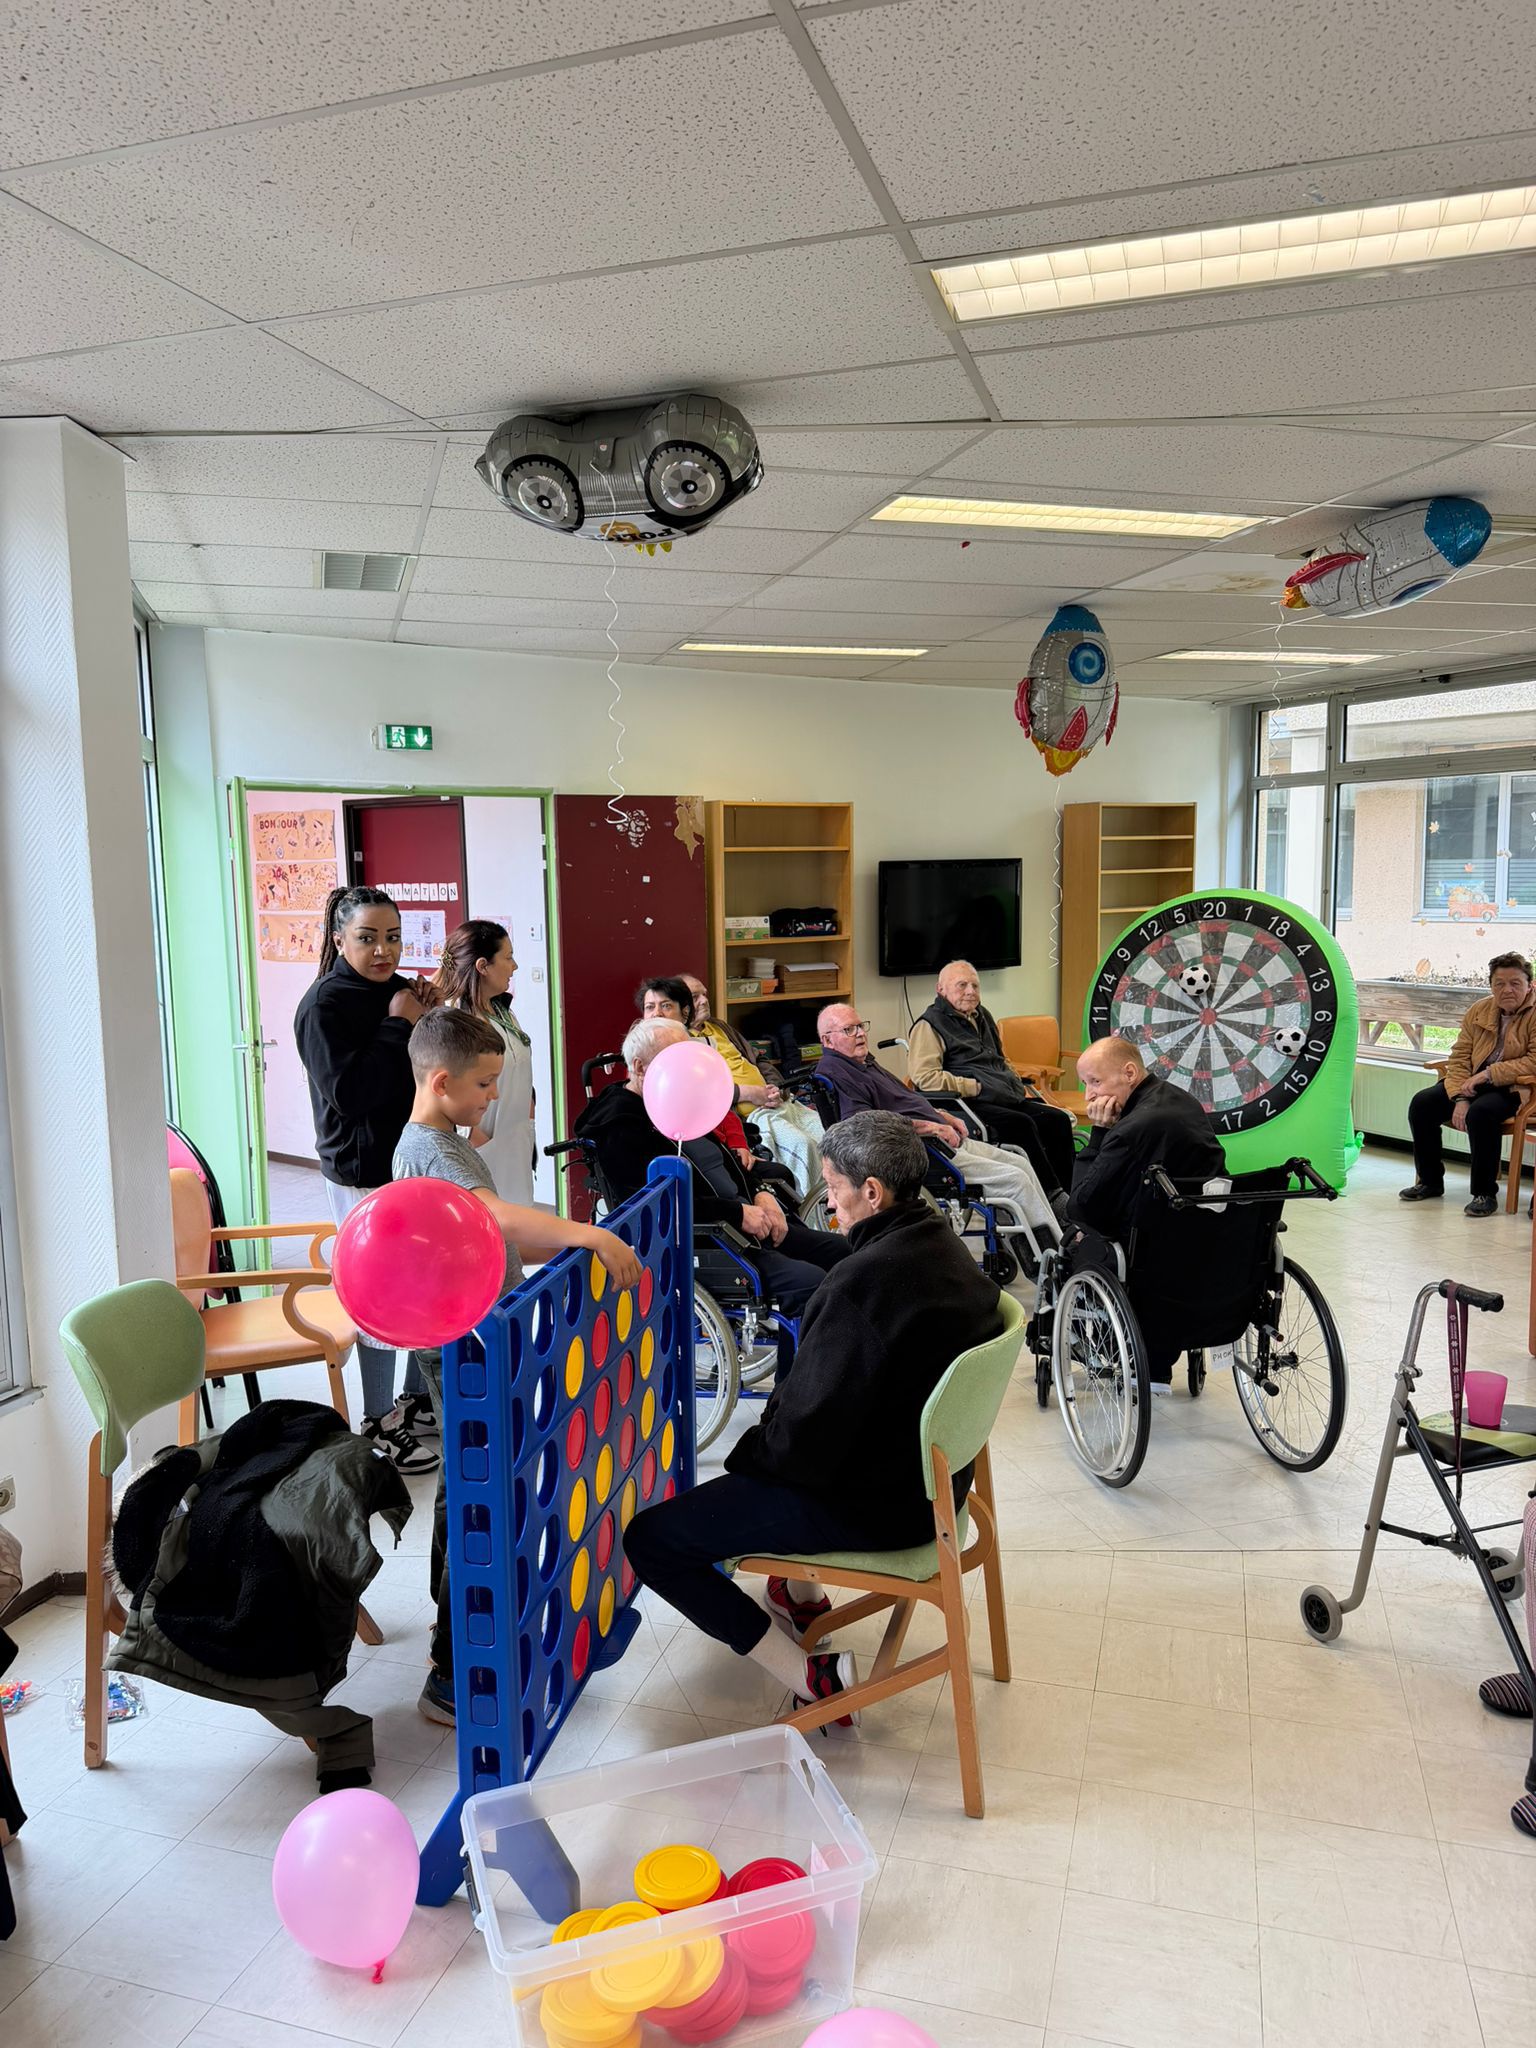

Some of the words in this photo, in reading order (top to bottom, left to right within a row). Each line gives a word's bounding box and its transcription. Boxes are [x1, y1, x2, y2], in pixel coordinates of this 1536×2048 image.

[379, 887, 457, 897] NIMATION
[1174, 908, 1186, 924] 5
[1203, 901, 1227, 919] 20
[1244, 905, 1254, 922] 1
[1139, 920, 1163, 942] 12
[1267, 915, 1291, 938] 18
[1116, 947, 1131, 962] 9
[1296, 943, 1313, 957] 4
[1098, 972, 1117, 993] 14
[1309, 967, 1330, 992] 13
[1092, 1006, 1108, 1024] 11
[1304, 1040, 1326, 1062] 10
[1283, 1070, 1308, 1095] 15
[1259, 1099, 1277, 1117] 2
[1221, 1111, 1244, 1131] 17
